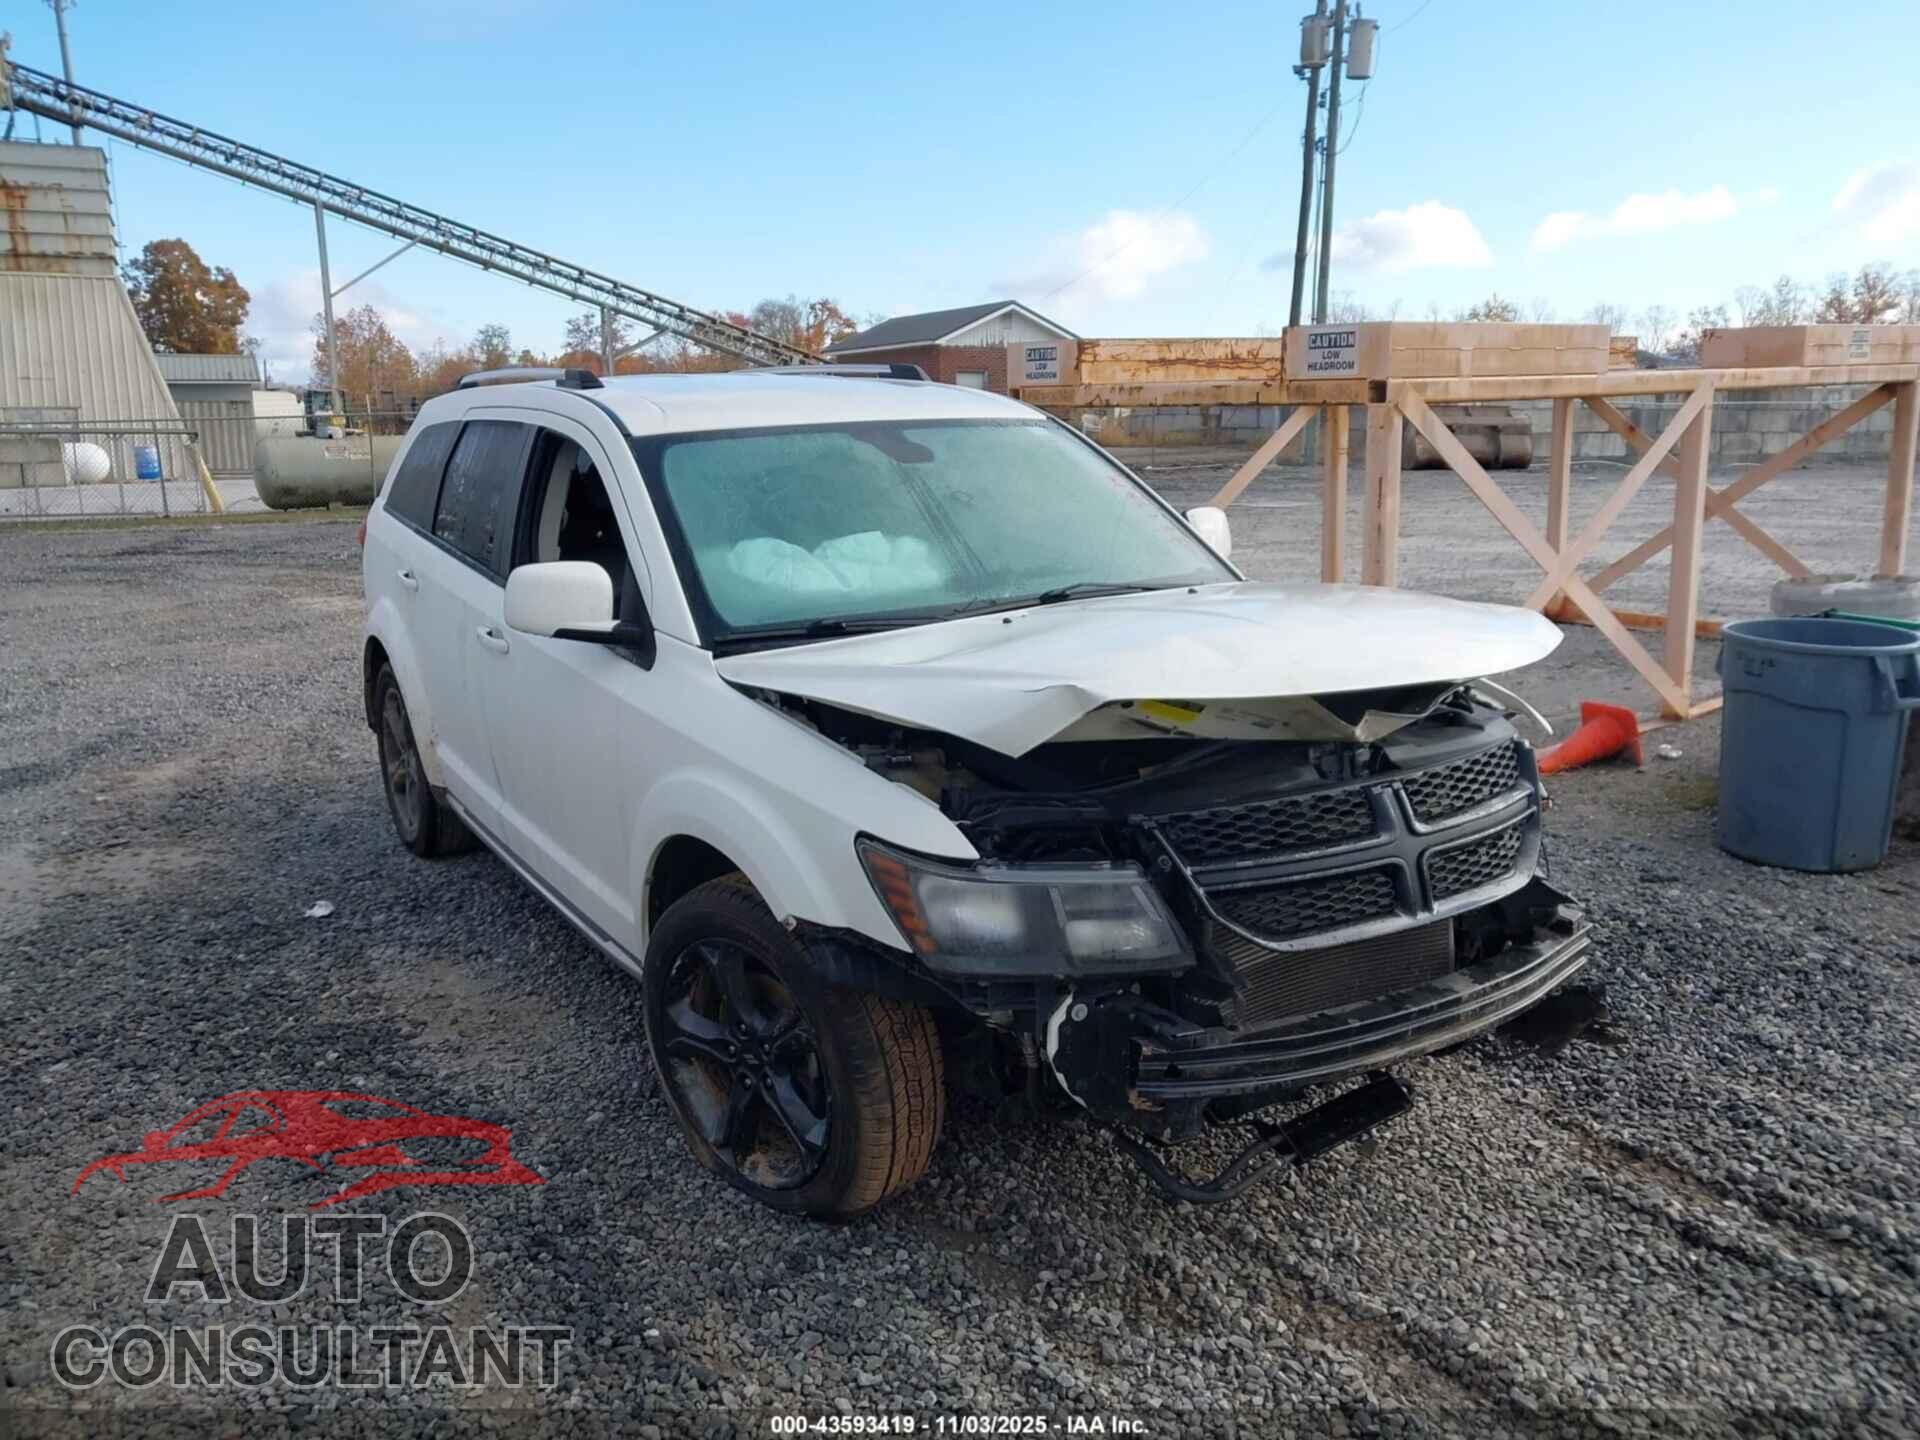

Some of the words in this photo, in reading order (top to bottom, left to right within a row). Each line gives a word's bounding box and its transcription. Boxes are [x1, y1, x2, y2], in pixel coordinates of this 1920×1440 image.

[1309, 332, 1355, 348] CAUTION
[1322, 350, 1341, 360] LOW
[1307, 361, 1355, 371] HEADROOM
